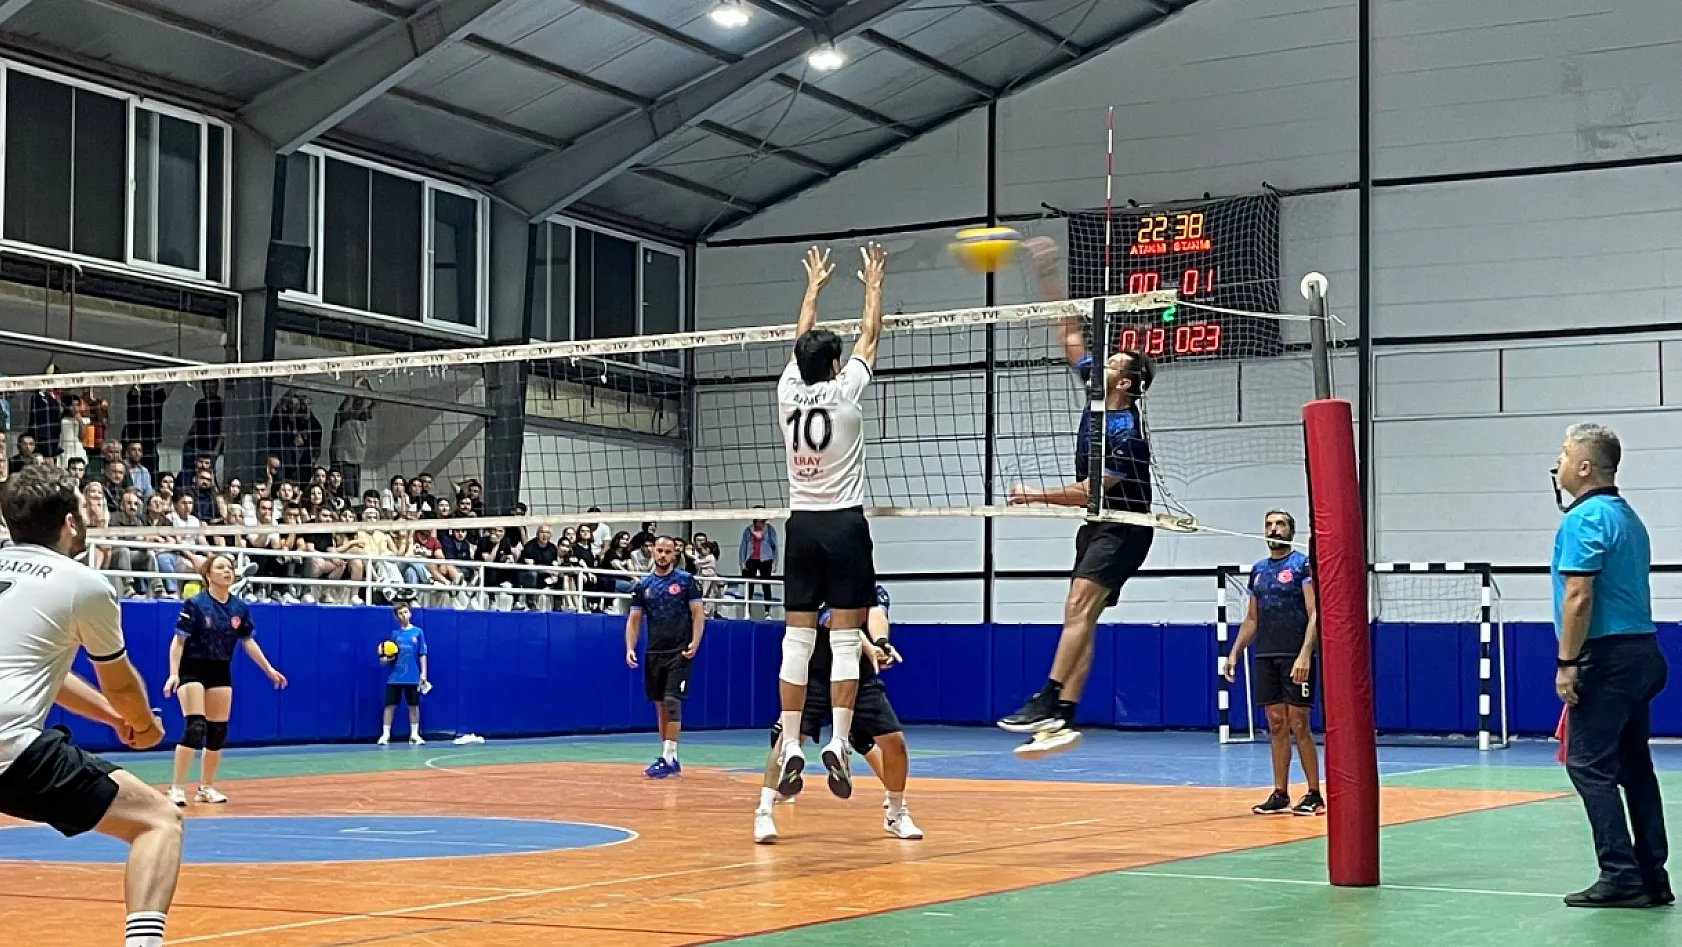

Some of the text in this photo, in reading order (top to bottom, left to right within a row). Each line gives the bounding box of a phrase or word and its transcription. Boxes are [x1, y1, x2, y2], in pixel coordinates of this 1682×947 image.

[1138, 213, 1203, 243] 22 38
[1176, 325, 1220, 353] 023
[786, 408, 832, 452] 10
[1301, 682, 1309, 697] 6
